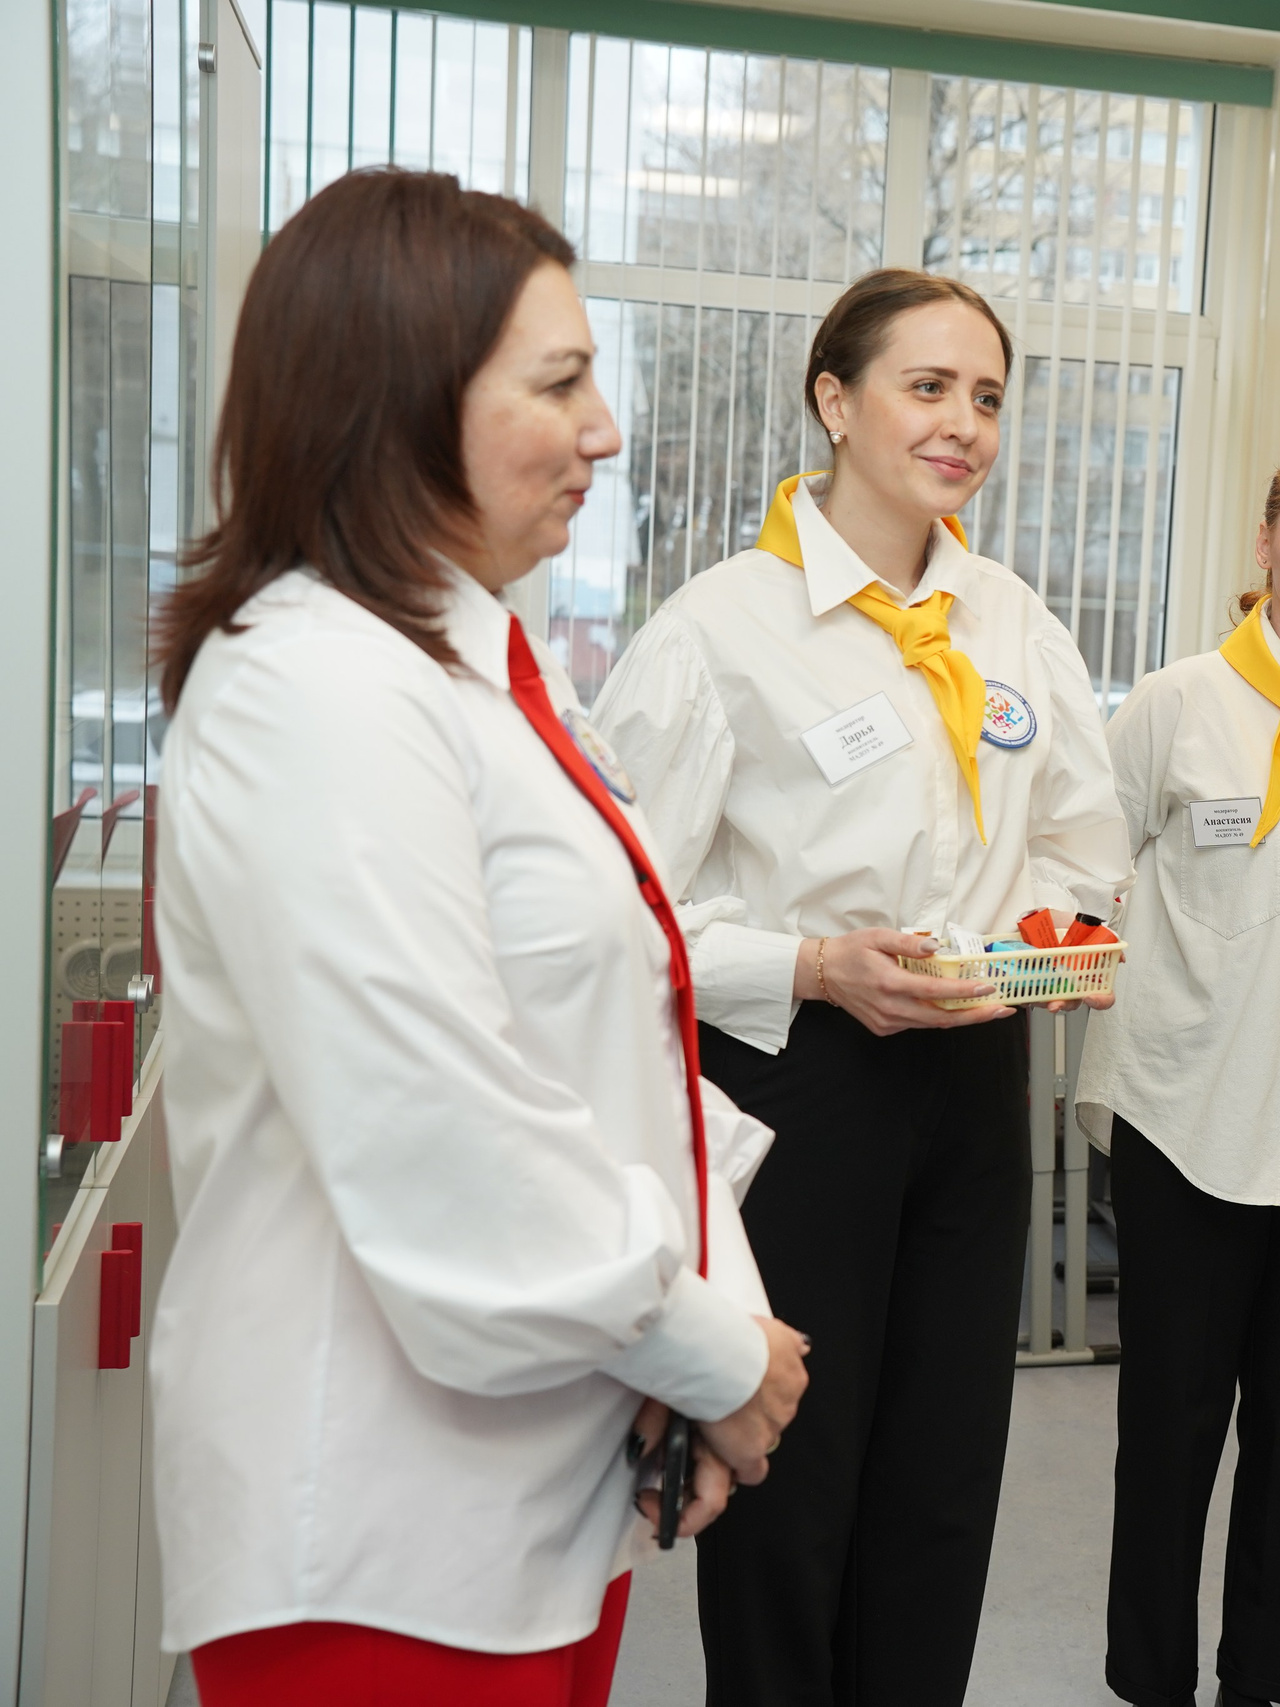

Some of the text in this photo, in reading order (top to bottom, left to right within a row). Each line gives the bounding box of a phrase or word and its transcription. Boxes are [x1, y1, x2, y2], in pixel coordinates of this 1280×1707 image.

[836, 716, 865, 732] модератор
[839, 724, 875, 750] Дарья
[847, 737, 878, 755] воспитатель
[849, 749, 870, 762] МАДОУ
[1204, 817, 1252, 826] Анастасия
